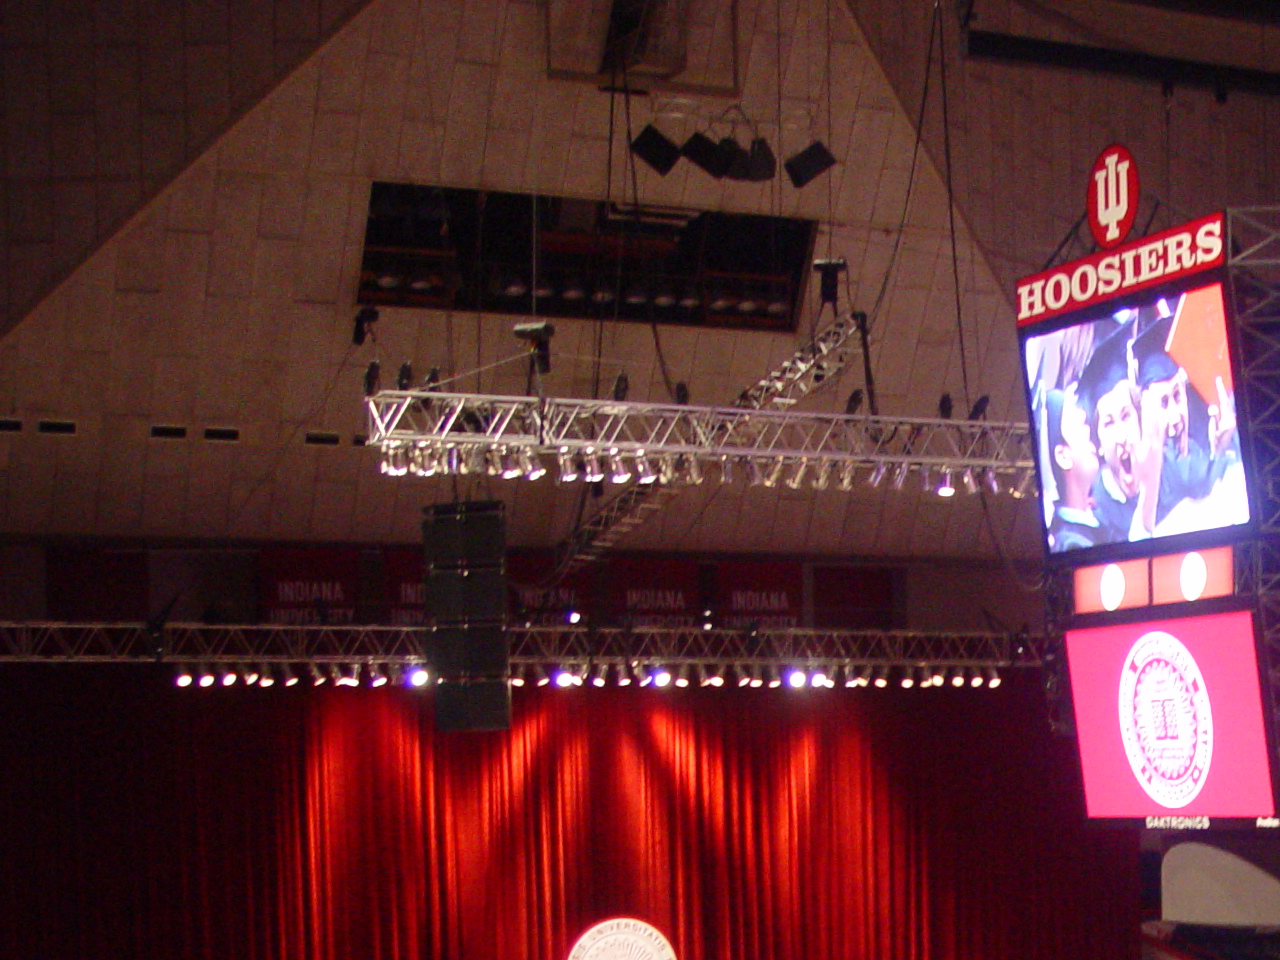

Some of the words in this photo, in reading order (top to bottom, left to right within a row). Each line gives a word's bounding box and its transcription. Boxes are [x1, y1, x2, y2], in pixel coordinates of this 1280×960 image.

[1017, 220, 1223, 321] HOOSIERS
[277, 581, 344, 603] INDIANA
[518, 588, 579, 607] INDANA
[626, 589, 685, 609] INDIANA
[731, 590, 790, 610] INDIANA
[269, 608, 356, 624] UNIVERITY
[1145, 815, 1210, 830] DAKTRONICS
